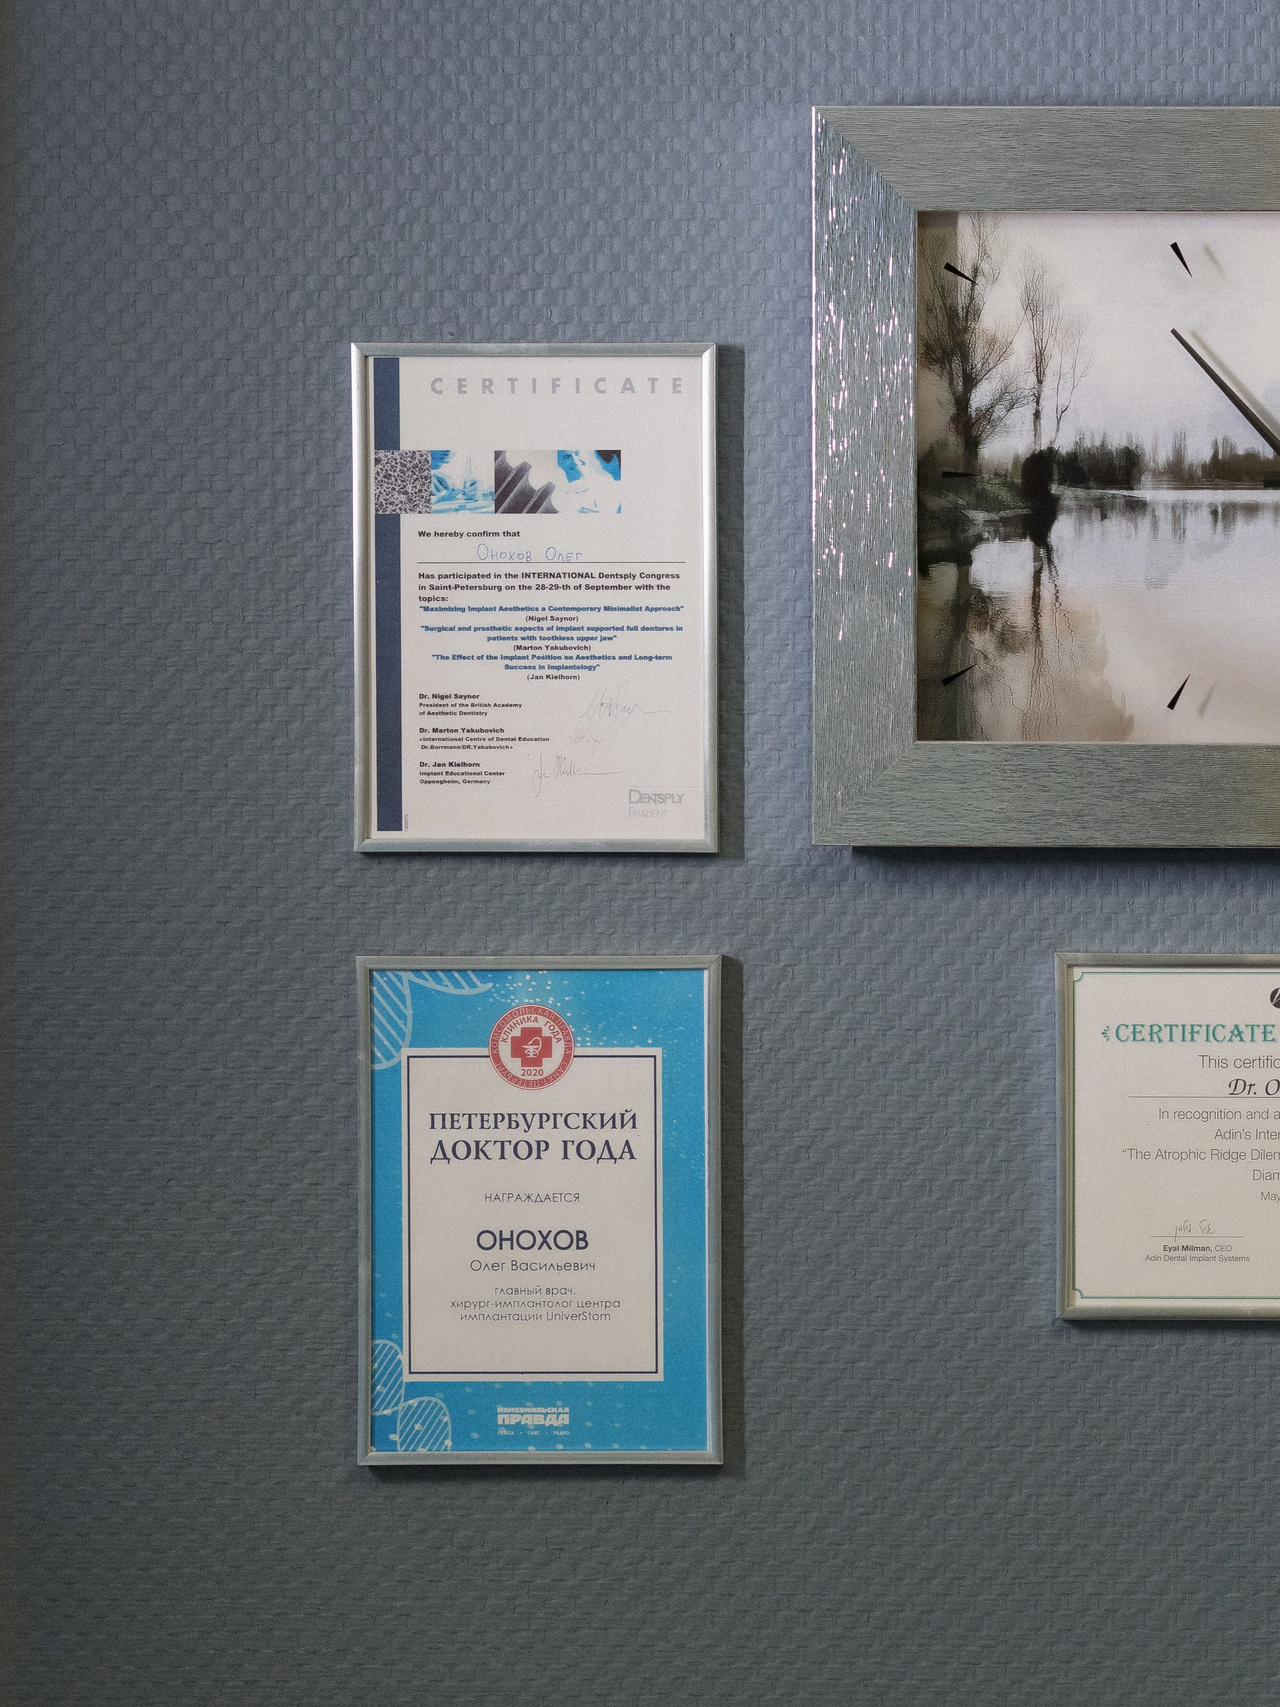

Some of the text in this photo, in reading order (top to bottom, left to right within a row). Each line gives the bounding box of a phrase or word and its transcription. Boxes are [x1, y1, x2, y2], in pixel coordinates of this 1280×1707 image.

[431, 377, 683, 395] CERTIFICATE
[417, 530, 521, 539] We hereby confirm that
[477, 543, 583, 562] Онохов Олег
[418, 572, 436, 580] Has
[437, 572, 492, 581] participated
[504, 571, 519, 580] the
[521, 571, 597, 579] INTERNATIONAL
[598, 571, 637, 581] Dentsply
[639, 571, 681, 581] Congress
[418, 583, 427, 591] in
[428, 583, 503, 593] Saint-Petersburg
[517, 583, 533, 591] the
[535, 583, 571, 591] 28-29-th
[573, 583, 583, 591] of
[584, 583, 633, 592] September
[634, 583, 655, 591] with
[655, 583, 671, 591] the
[418, 595, 449, 604] topics:
[525, 615, 579, 623] (Nigel Saynor)
[431, 693, 452, 701] Nigel
[453, 693, 481, 701] Saynor
[500, 1015, 563, 1044] КЛИНИКА ГОДА
[1116, 1024, 1276, 1043] CERTIFICATE
[1197, 1054, 1229, 1069] This
[520, 1068, 544, 1077] 2020
[1228, 1078, 1257, 1096] Dr.
[428, 1107, 639, 1132] ПЕТЕРБУРГСКИЙ
[1158, 1107, 1170, 1120] In
[1173, 1108, 1242, 1123] recognition
[1245, 1108, 1270, 1121] and
[430, 1140, 636, 1164] ДОКТОР ГОДА
[1154, 1148, 1207, 1163] Atrophic
[1211, 1149, 1249, 1163] Ridge
[484, 1192, 580, 1204] НАГРАЖДАЕТСЯ
[477, 1230, 588, 1250] ОНОХОВ
[1163, 1244, 1233, 1255] Eyal Milman, CEO
[1144, 1252, 1251, 1264] Adin Dental Implant Systems
[469, 1259, 596, 1272] Олег Васильевич
[494, 1284, 576, 1298] главный врач,
[449, 1297, 621, 1311] хирург-имплантолог центра
[460, 1309, 611, 1322] имплантации UniverStom
[497, 1414, 570, 1426] ПРАВДА
